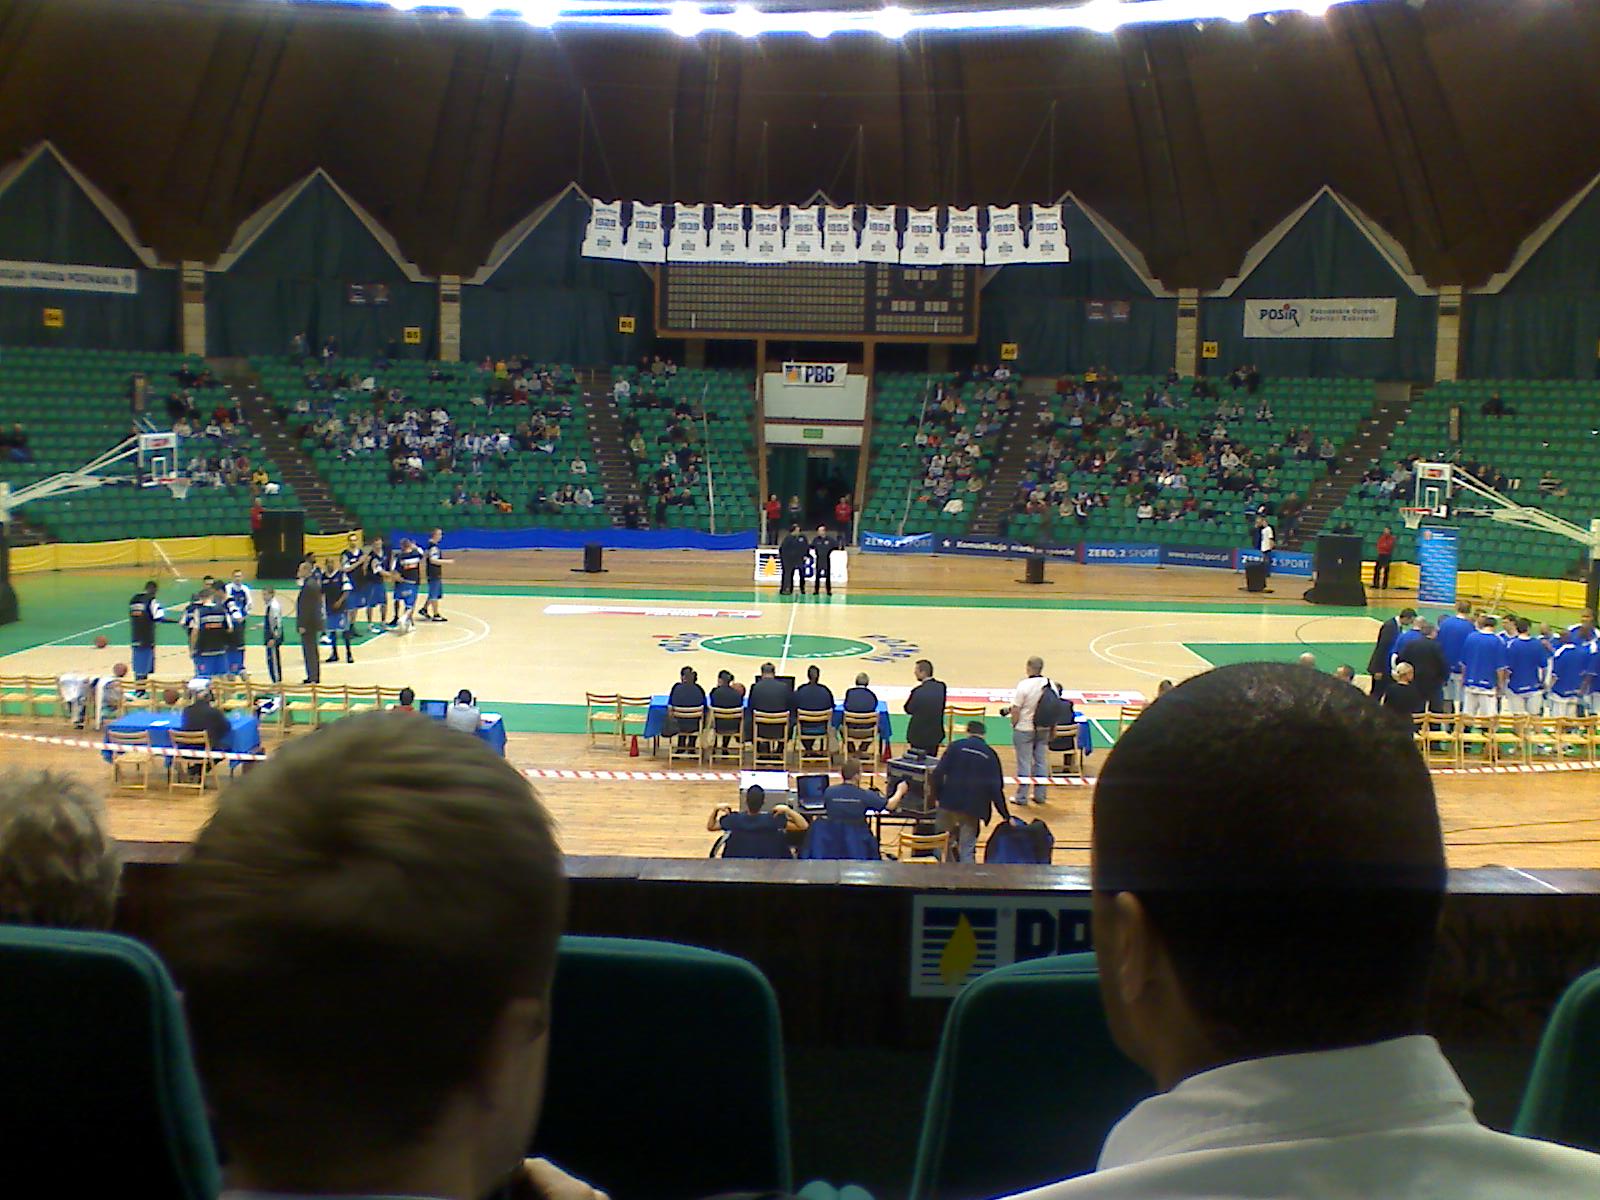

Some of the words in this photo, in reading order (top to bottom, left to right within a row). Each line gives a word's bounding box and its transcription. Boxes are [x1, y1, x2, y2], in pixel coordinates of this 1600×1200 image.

[805, 365, 835, 383] PBG
[1128, 548, 1159, 558] SPORT
[1279, 559, 1310, 569] SPORT
